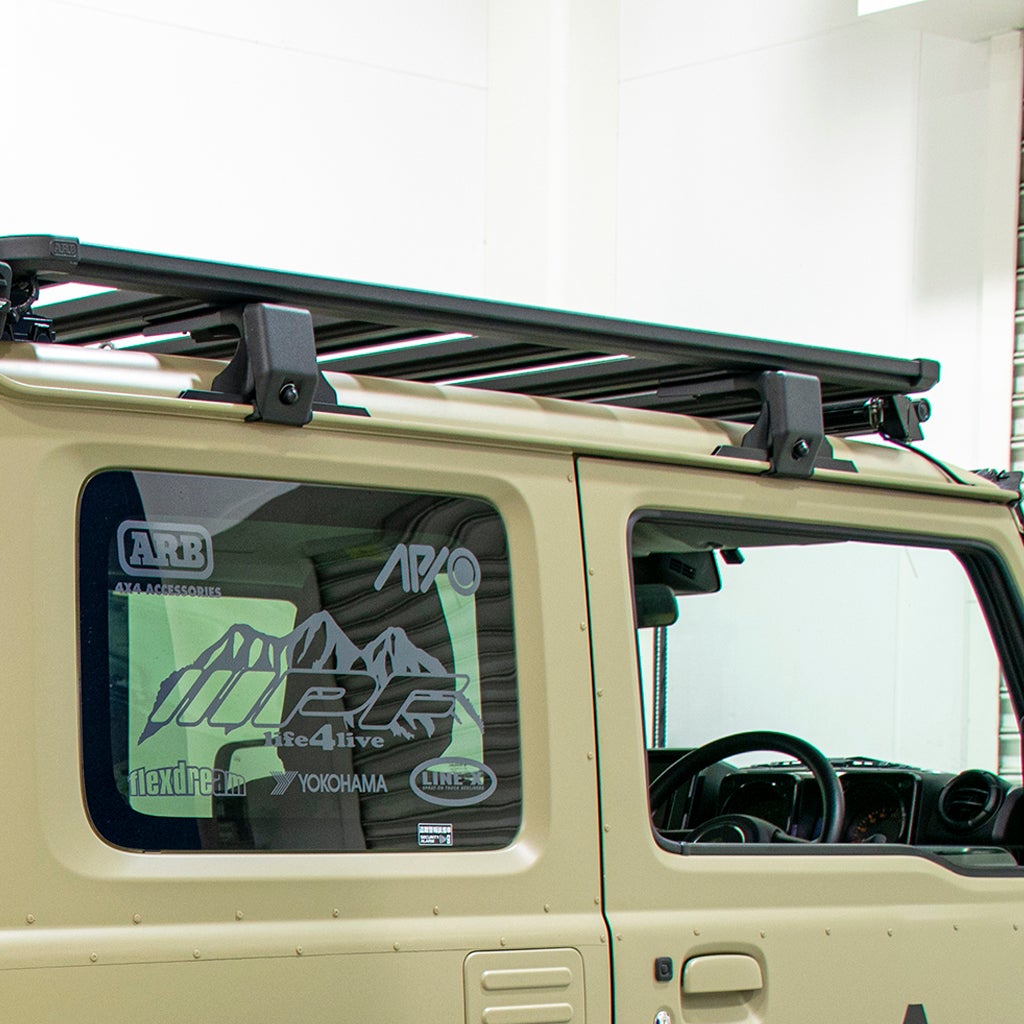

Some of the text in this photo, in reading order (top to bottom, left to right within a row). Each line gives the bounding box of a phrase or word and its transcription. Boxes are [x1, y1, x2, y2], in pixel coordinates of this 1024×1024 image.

[129, 531, 205, 568] ARB
[145, 583, 222, 598] ACCESSORIES
[262, 724, 385, 751] life4live
[128, 760, 247, 797] flexdream
[298, 774, 388, 793] YOKOHAMA
